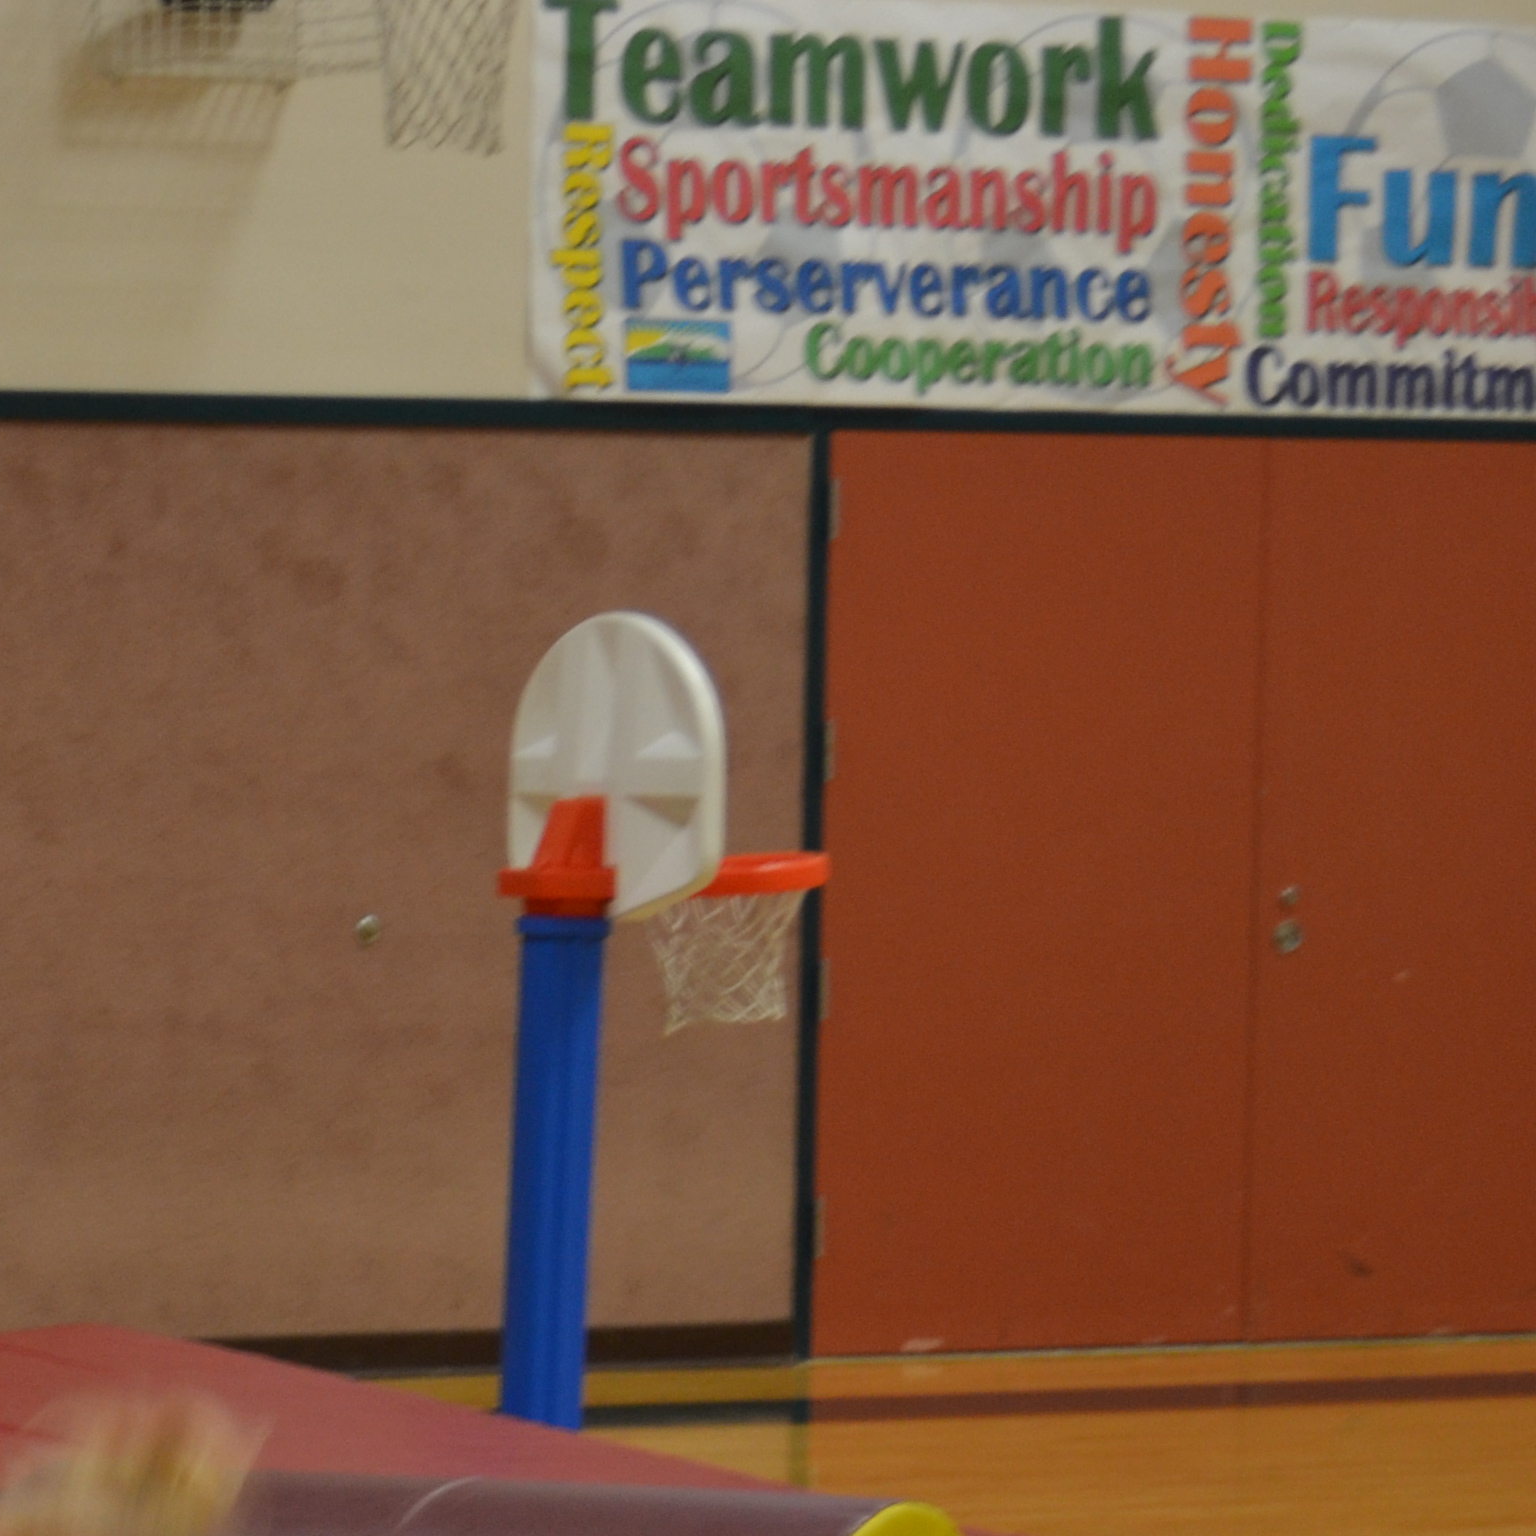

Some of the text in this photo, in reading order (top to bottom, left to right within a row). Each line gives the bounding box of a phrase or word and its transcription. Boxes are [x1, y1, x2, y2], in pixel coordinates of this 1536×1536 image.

[544, 0, 1158, 141] Teamwork
[550, 122, 614, 392] Respect
[616, 135, 1158, 255] Sportsmanship
[1164, 15, 1254, 406] Honesty
[1307, 135, 1536, 268] Fun
[620, 238, 1153, 324] Perserverance
[804, 321, 1154, 395] Cooperation
